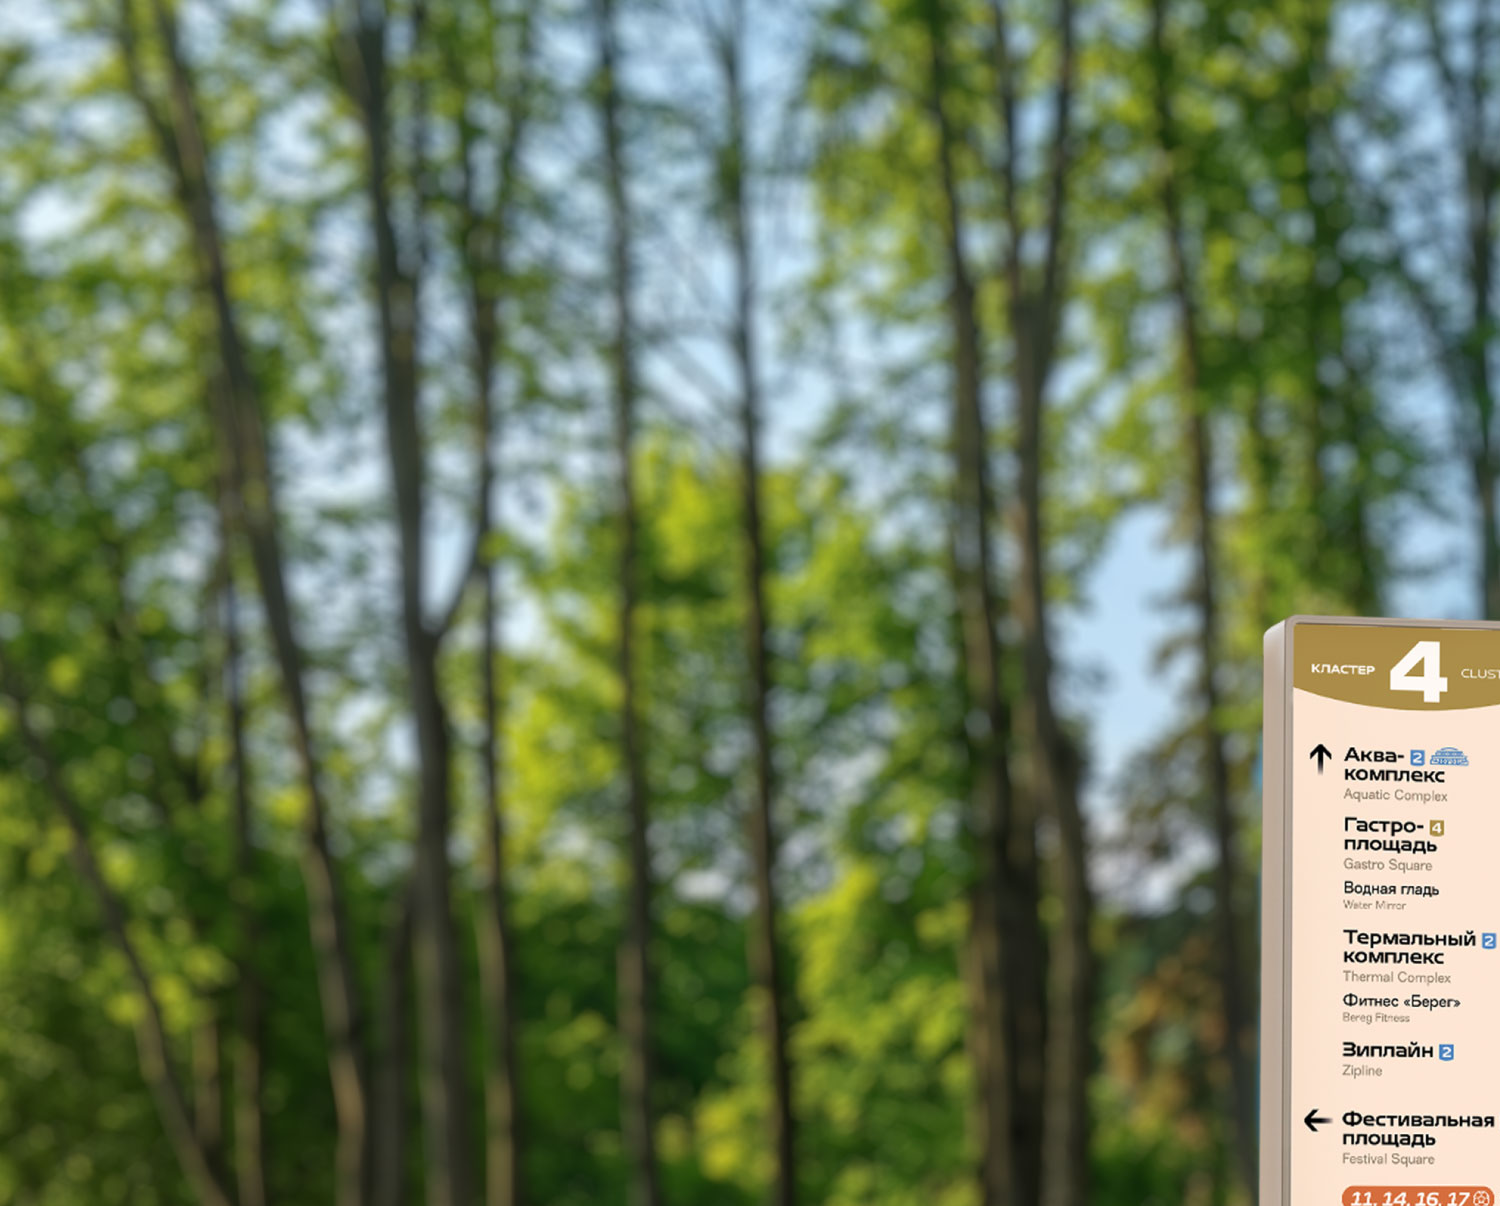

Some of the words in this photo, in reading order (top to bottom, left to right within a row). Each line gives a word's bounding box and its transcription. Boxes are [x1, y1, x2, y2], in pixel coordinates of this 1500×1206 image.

[1311, 663, 1375, 675] КЛАСТЕР
[1390, 640, 1448, 703] 4
[1344, 747, 1404, 763] Аква-
[1344, 768, 1446, 783] комплекс
[1343, 788, 1390, 801] Aquatic
[1394, 789, 1448, 804] Complex
[1344, 817, 1424, 836] Гастро-
[1344, 838, 1437, 854] площадь
[1343, 858, 1385, 871] Gastro
[1389, 859, 1432, 874] Square
[1344, 881, 1397, 896] Водная
[1401, 884, 1440, 897] гладь
[1343, 899, 1372, 909] Water
[1343, 929, 1476, 948] Термальный
[1343, 950, 1445, 964] комплекс
[1343, 970, 1394, 983] Thermal
[1397, 971, 1451, 986] Complex
[1343, 993, 1399, 1007] Фитнес
[1403, 994, 1461, 1011] «Берег»
[1342, 1012, 1373, 1024] Bereg
[1375, 1013, 1410, 1023] Fitness
[1342, 1041, 1433, 1058] Зиплайн
[1342, 1065, 1383, 1079] Zipline
[1342, 1111, 1495, 1128] Фестивальная
[1342, 1133, 1436, 1148] площадь
[1342, 1153, 1387, 1165] Festival
[1391, 1153, 1435, 1167] Square
[1447, 1192, 1470, 1206] 17
